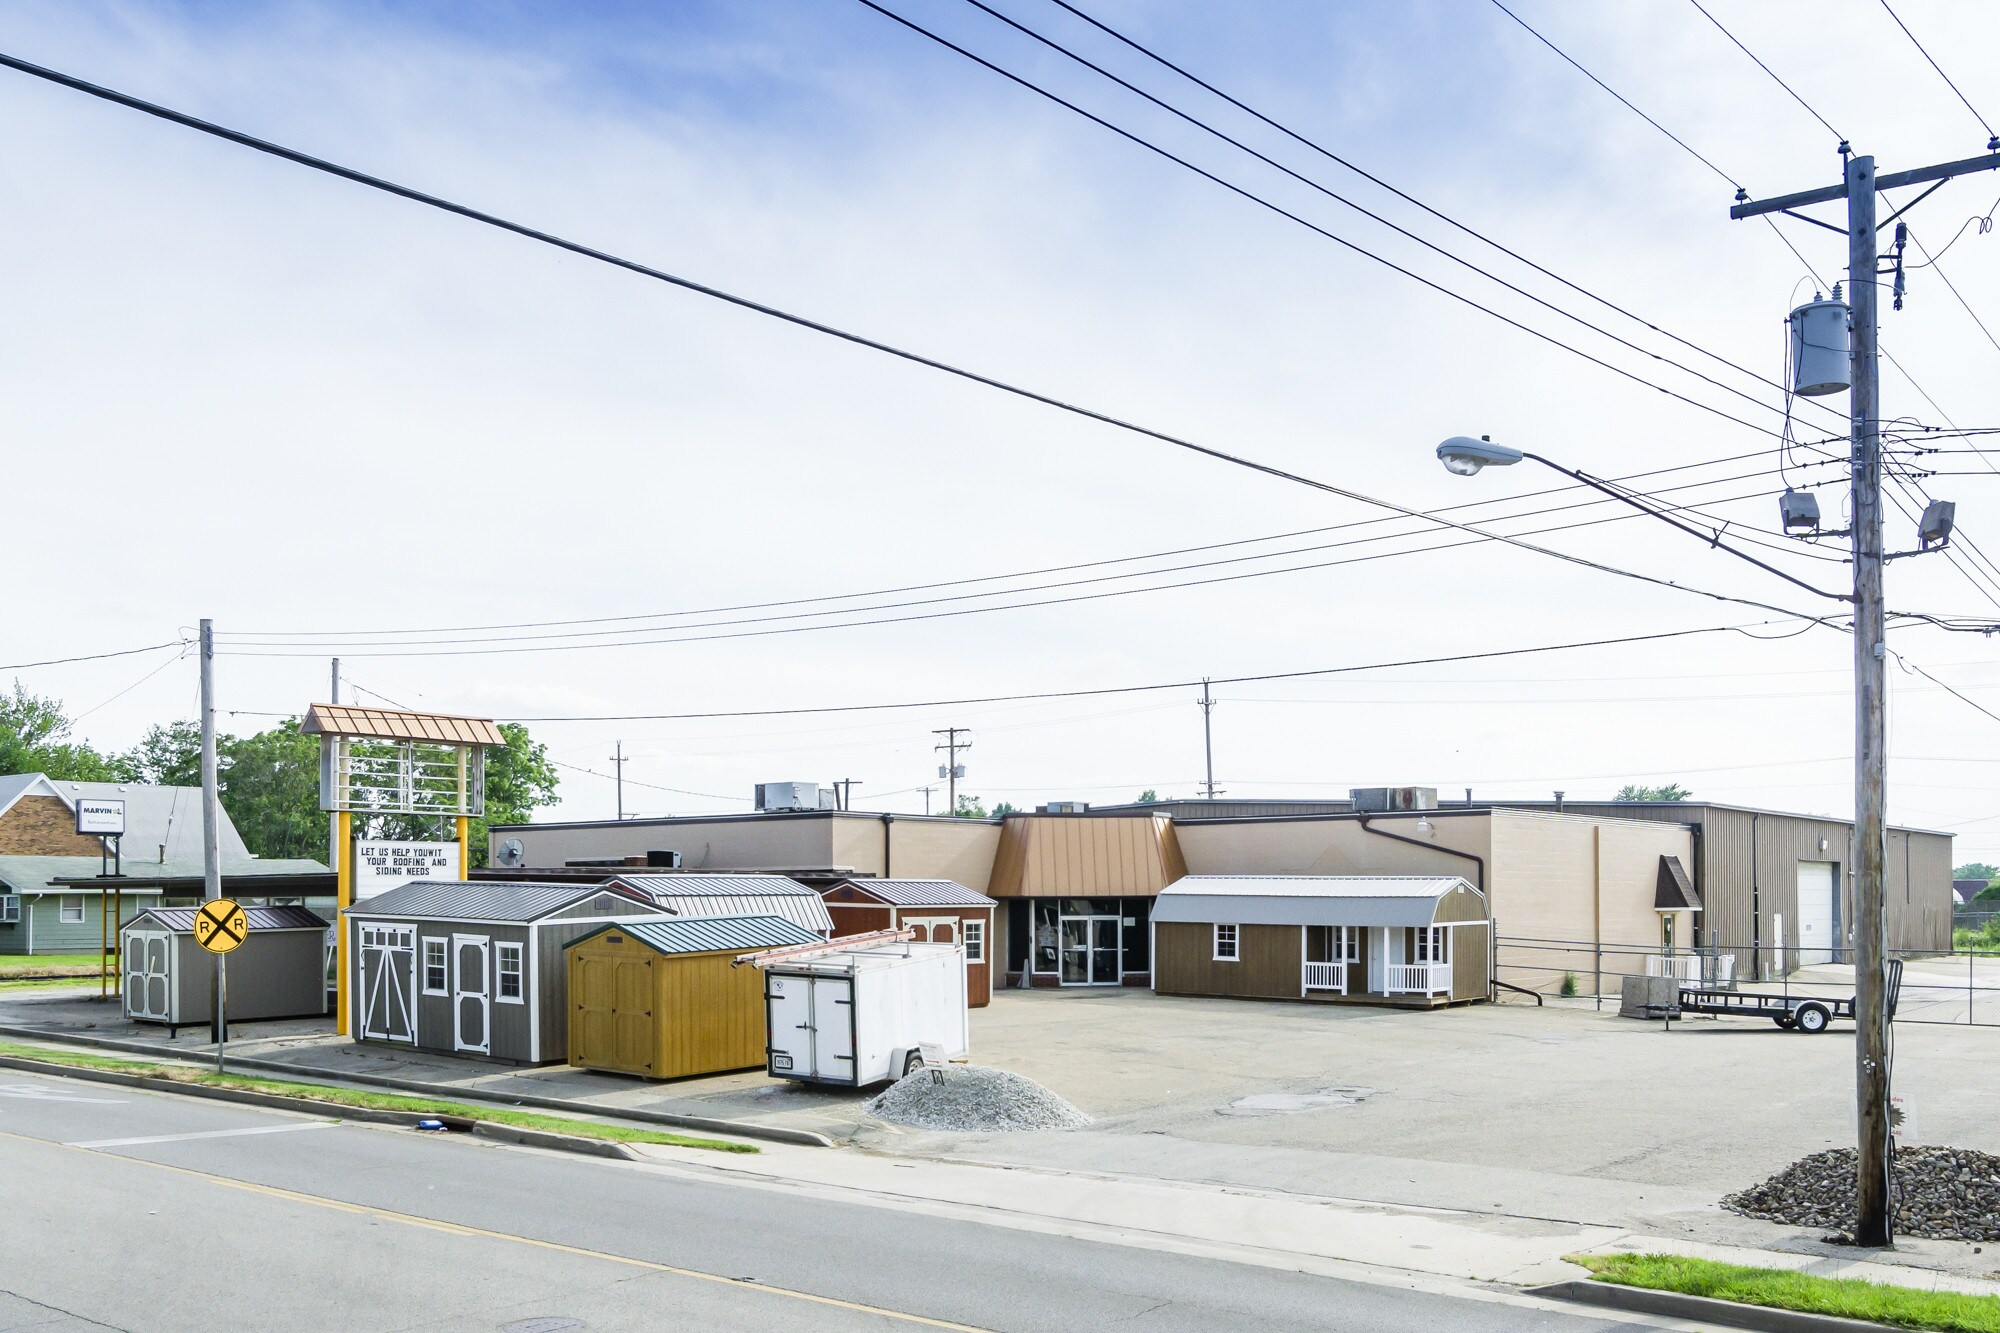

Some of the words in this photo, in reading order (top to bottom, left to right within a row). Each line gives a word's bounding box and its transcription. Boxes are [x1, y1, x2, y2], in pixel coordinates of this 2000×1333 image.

[361, 847, 375, 856] LET
[378, 848, 389, 856] US
[391, 848, 410, 856] HELP
[366, 857, 387, 866] YOUR
[393, 858, 425, 866] ROOFING
[432, 858, 447, 866] AND
[375, 866, 402, 875] SIDING
[406, 867, 430, 876] NEEDS
[200, 921, 210, 933] R
[234, 918, 244, 930] R
